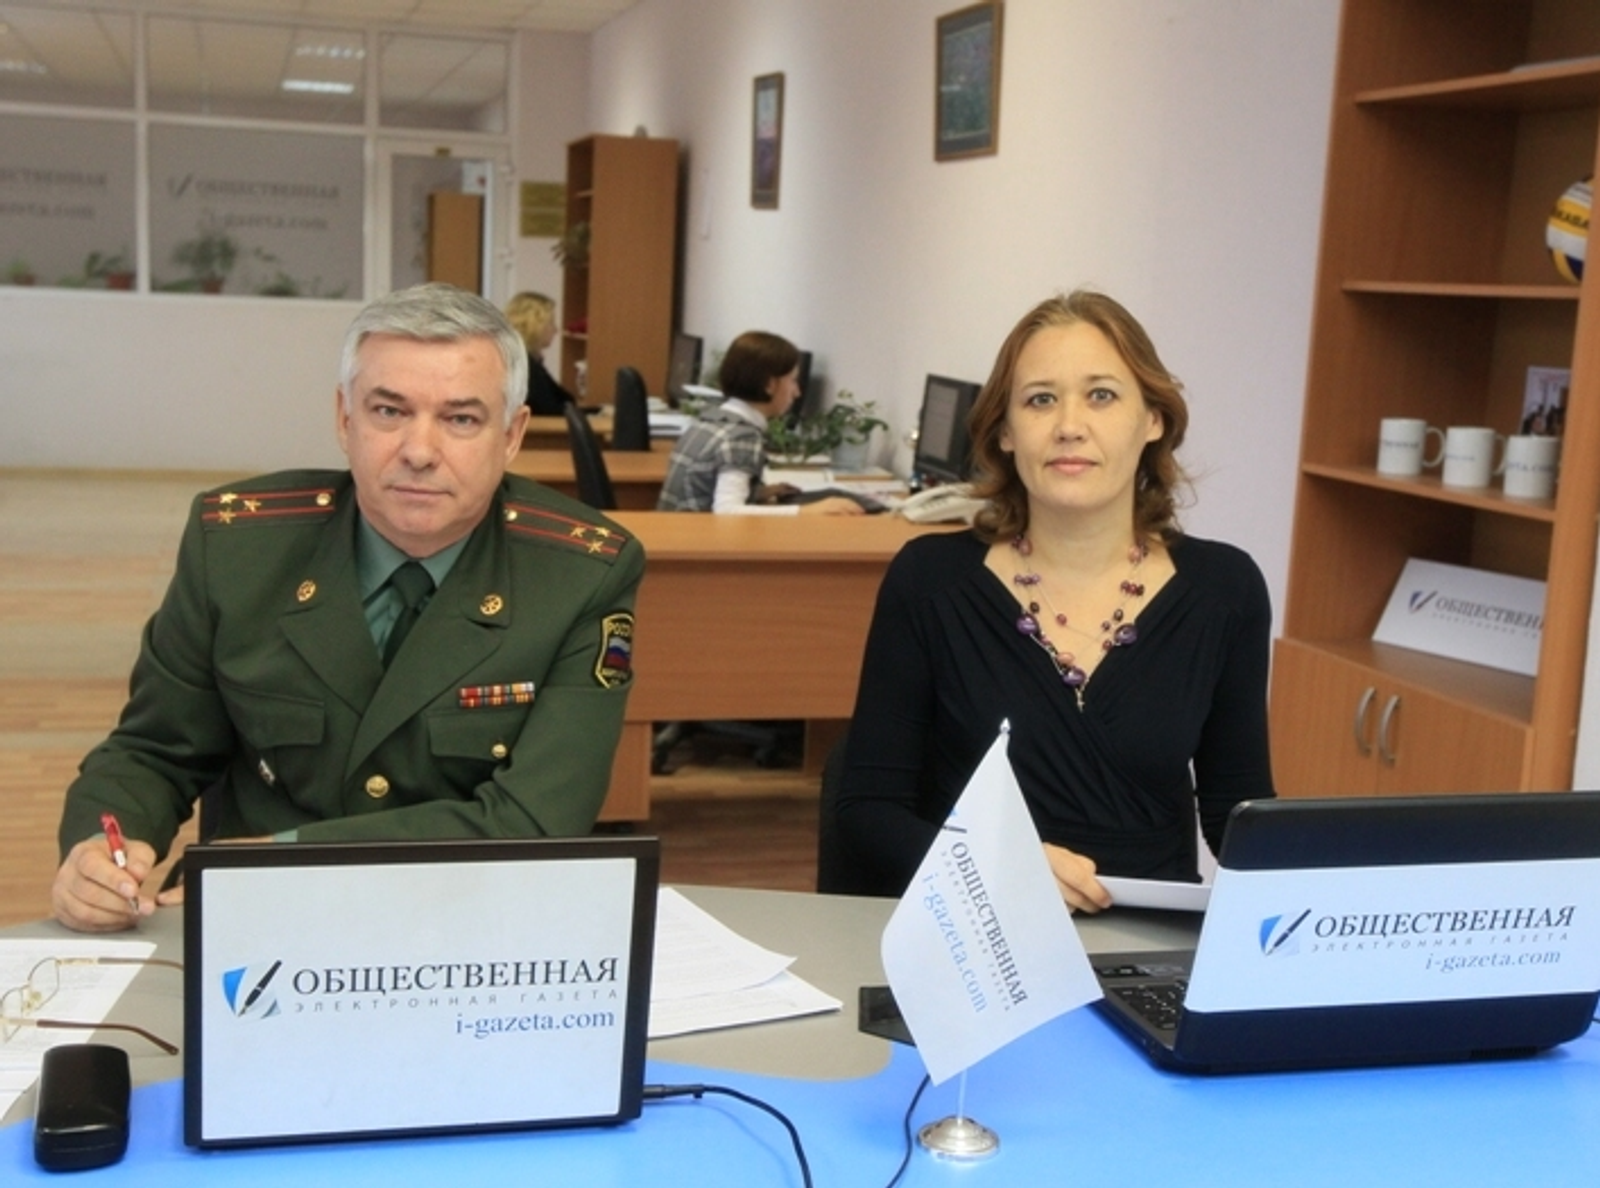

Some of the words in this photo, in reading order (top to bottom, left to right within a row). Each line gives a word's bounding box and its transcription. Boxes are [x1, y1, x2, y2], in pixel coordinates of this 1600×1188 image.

[951, 842, 1029, 1005] ОБЩЕСТВЕННАЯ
[1314, 906, 1576, 938] ОБЩЕСТВЕННАЯ
[922, 872, 988, 1013] i-gazeta.com
[1313, 938, 1473, 953] ЭЛЕКТРОННАЯ
[1491, 932, 1569, 945] ГАЗЕТА
[293, 957, 618, 995] ОБЩЕСТВЕННАЯ
[1425, 950, 1561, 974] i-gazeta.com
[294, 994, 497, 1013] ЭЛЕКТРОННАЯ
[520, 989, 618, 1004] ГАЗЕТА
[457, 1009, 615, 1039] i-gazeta.com
